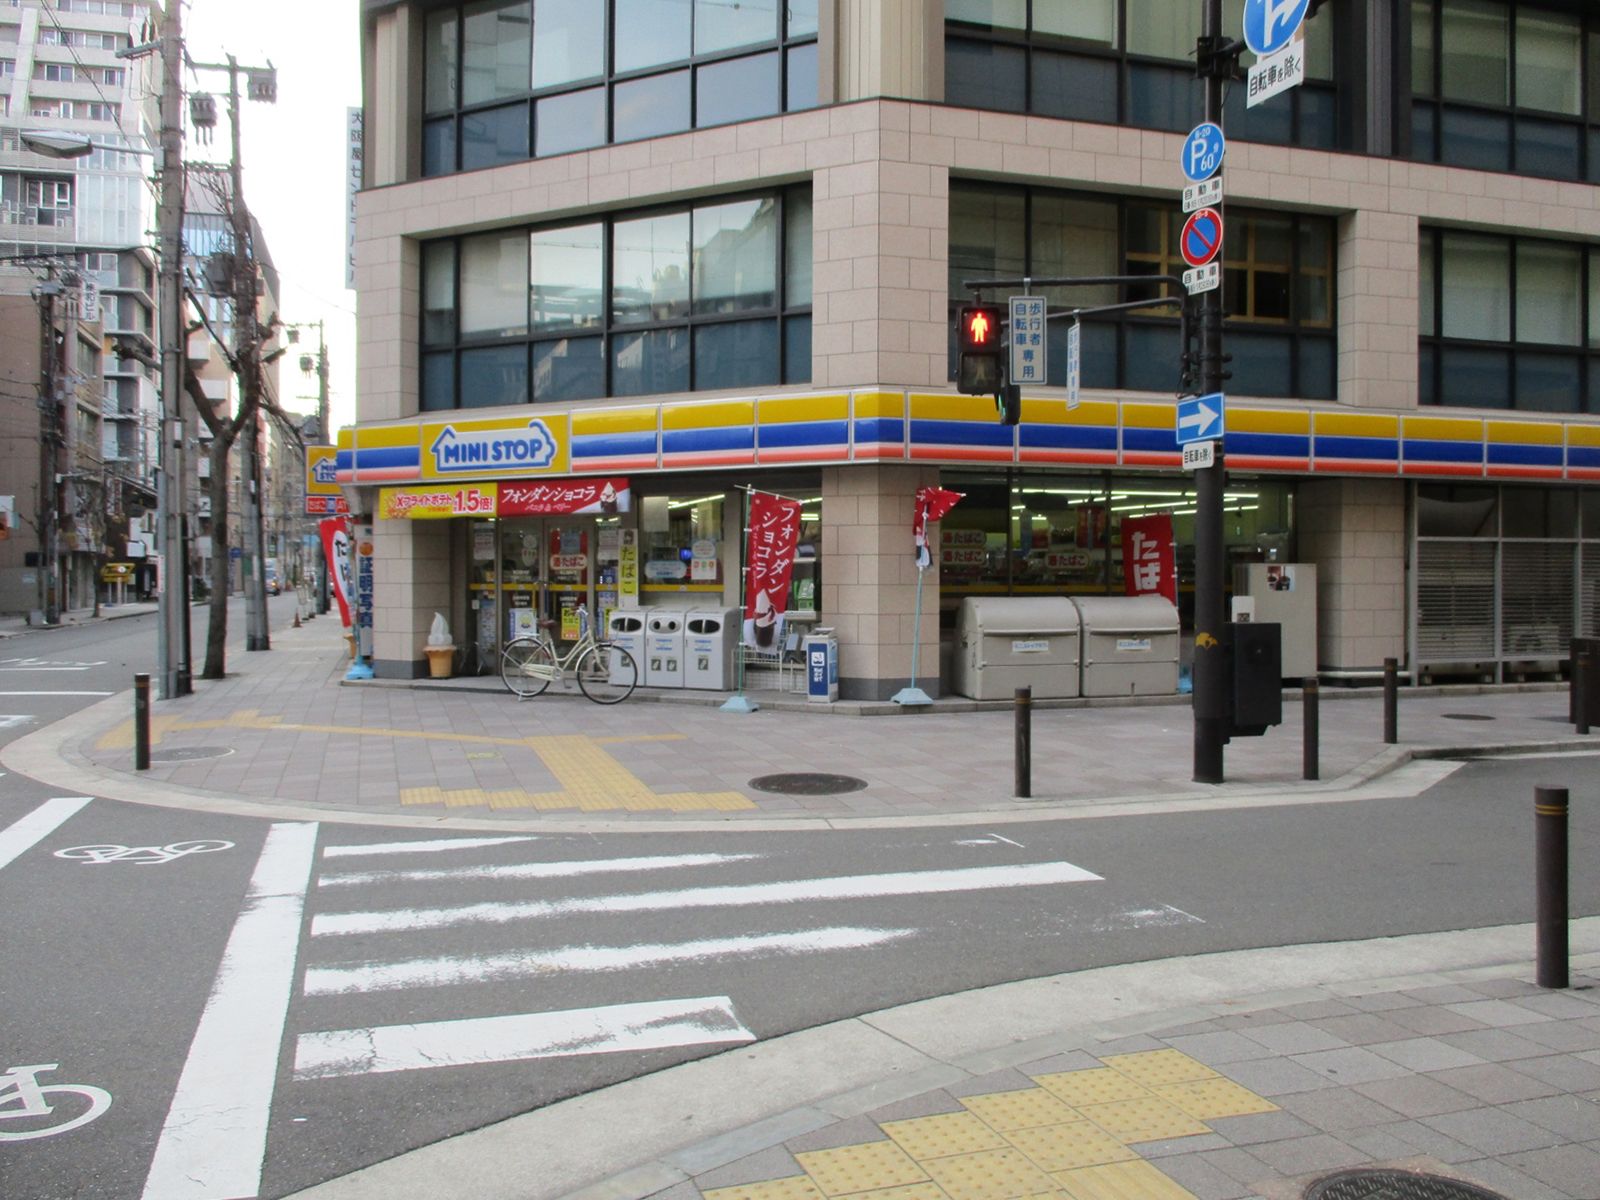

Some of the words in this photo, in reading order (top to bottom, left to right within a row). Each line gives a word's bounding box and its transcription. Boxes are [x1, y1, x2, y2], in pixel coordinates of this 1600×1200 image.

[1250, 54, 1301, 97] 自転車を除く
[1190, 138, 1207, 175] P
[1015, 303, 1027, 345] 自転車
[1029, 303, 1041, 345] 歩行者
[1022, 349, 1035, 378] 専用
[444, 441, 488, 464] MINI
[492, 438, 543, 462] STOP
[319, 472, 336, 481] STO
[502, 485, 596, 503] フォンダンショコラ
[756, 512, 778, 580] ショコラ
[768, 506, 795, 594] フォンダン
[1131, 531, 1161, 596] たば
[622, 546, 635, 594] たばこ
[359, 557, 373, 628] 証明写真
